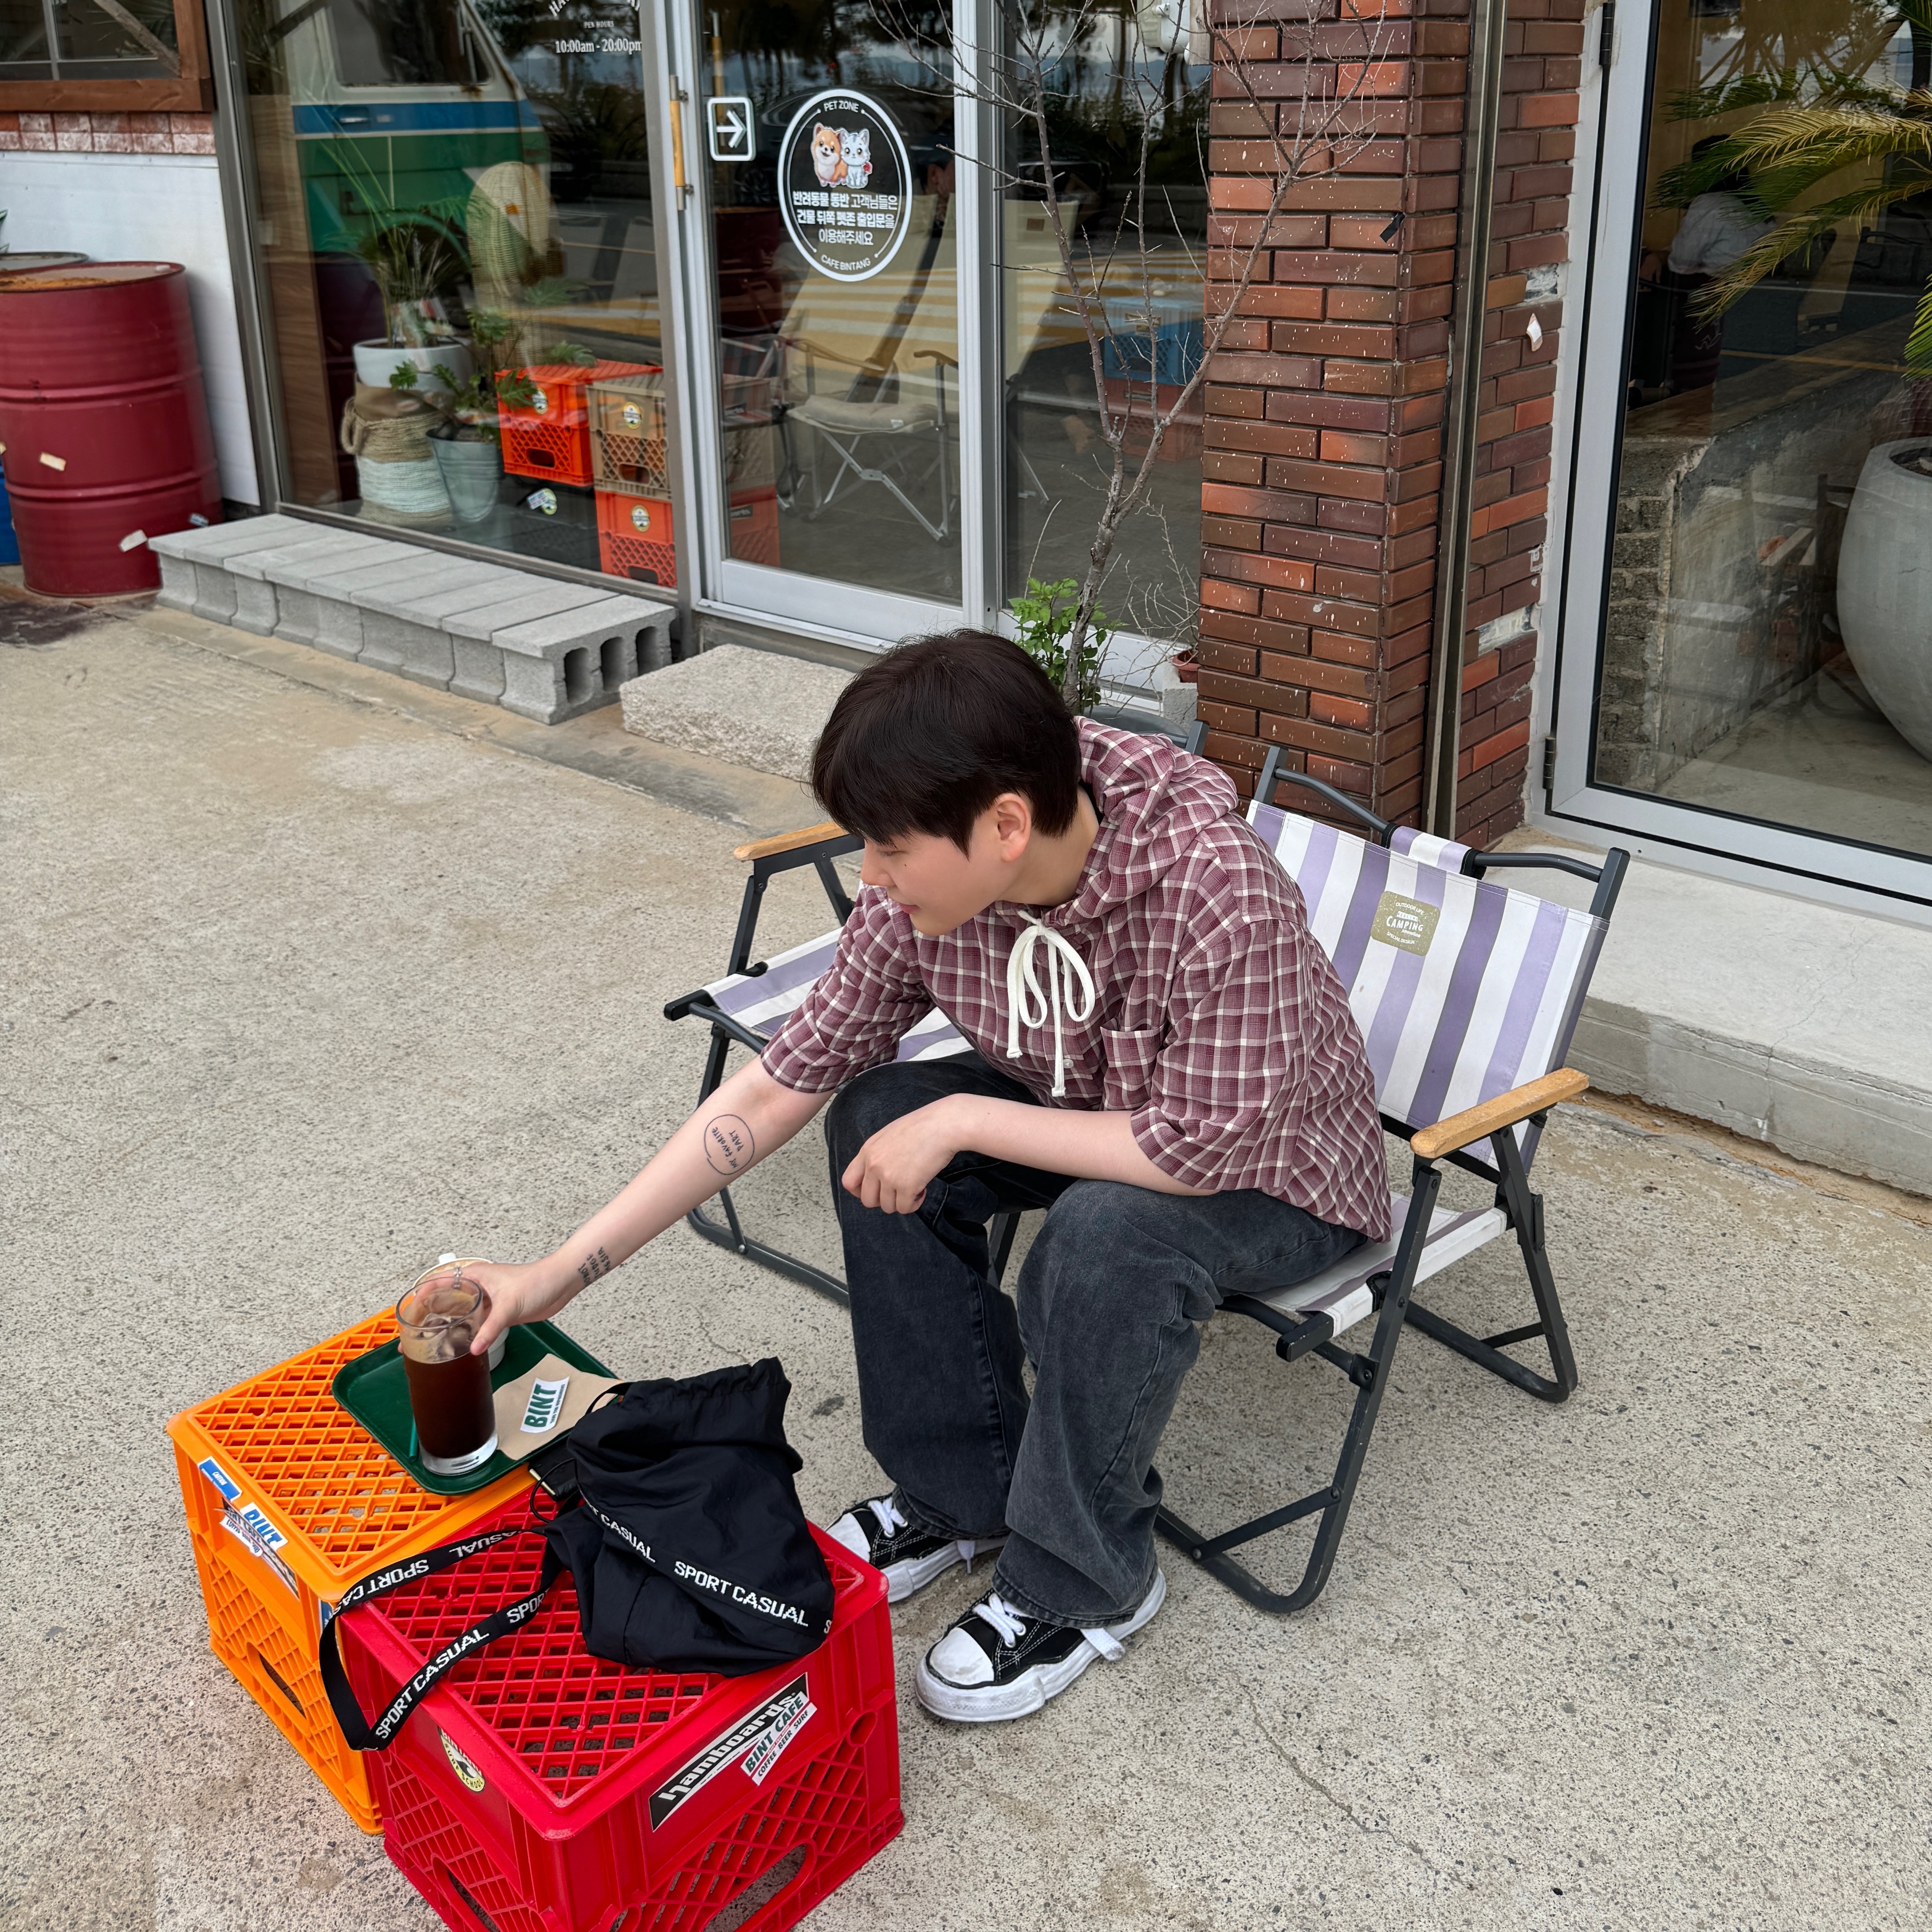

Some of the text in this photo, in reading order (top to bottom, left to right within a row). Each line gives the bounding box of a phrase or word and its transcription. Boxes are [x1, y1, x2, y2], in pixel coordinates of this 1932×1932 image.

[556, 40, 594, 53] 10:00am
[601, 38, 642, 54] 20:00pm
[824, 100, 859, 113] PET ZONE
[793, 191, 898, 210] 반려동물 동반 고객님들은
[797, 209, 895, 228] 건물 뒤쪽 펫존 출입문을
[819, 228, 874, 245] 이용해주세요
[820, 254, 871, 271] CAFE BINTANG
[1395, 902, 1416, 911] OUTDOOR
[1386, 915, 1424, 931] CAMPING
[712, 1127, 739, 1168] MY FAVORITE
[729, 1130, 744, 1152] PART
[524, 1383, 557, 1427] BINT
[449, 1530, 523, 1558] ASUAL
[600, 1513, 656, 1563] CASUAL
[368, 1559, 429, 1593] SPORT
[674, 1560, 733, 1596] SPORT
[731, 1585, 809, 1628] CASUAL
[375, 1686, 413, 1739] SPORT
[413, 1628, 490, 1692] CASUAL
[658, 1695, 794, 1801] hamboards
[745, 1731, 772, 1773] BINT
[775, 1696, 804, 1733] CAFE
[758, 1750, 777, 1777] COFFEE
[777, 1730, 793, 1750] BEER
[794, 1710, 809, 1729] SURF
[444, 1743, 483, 1789] SURF SCHOOL
